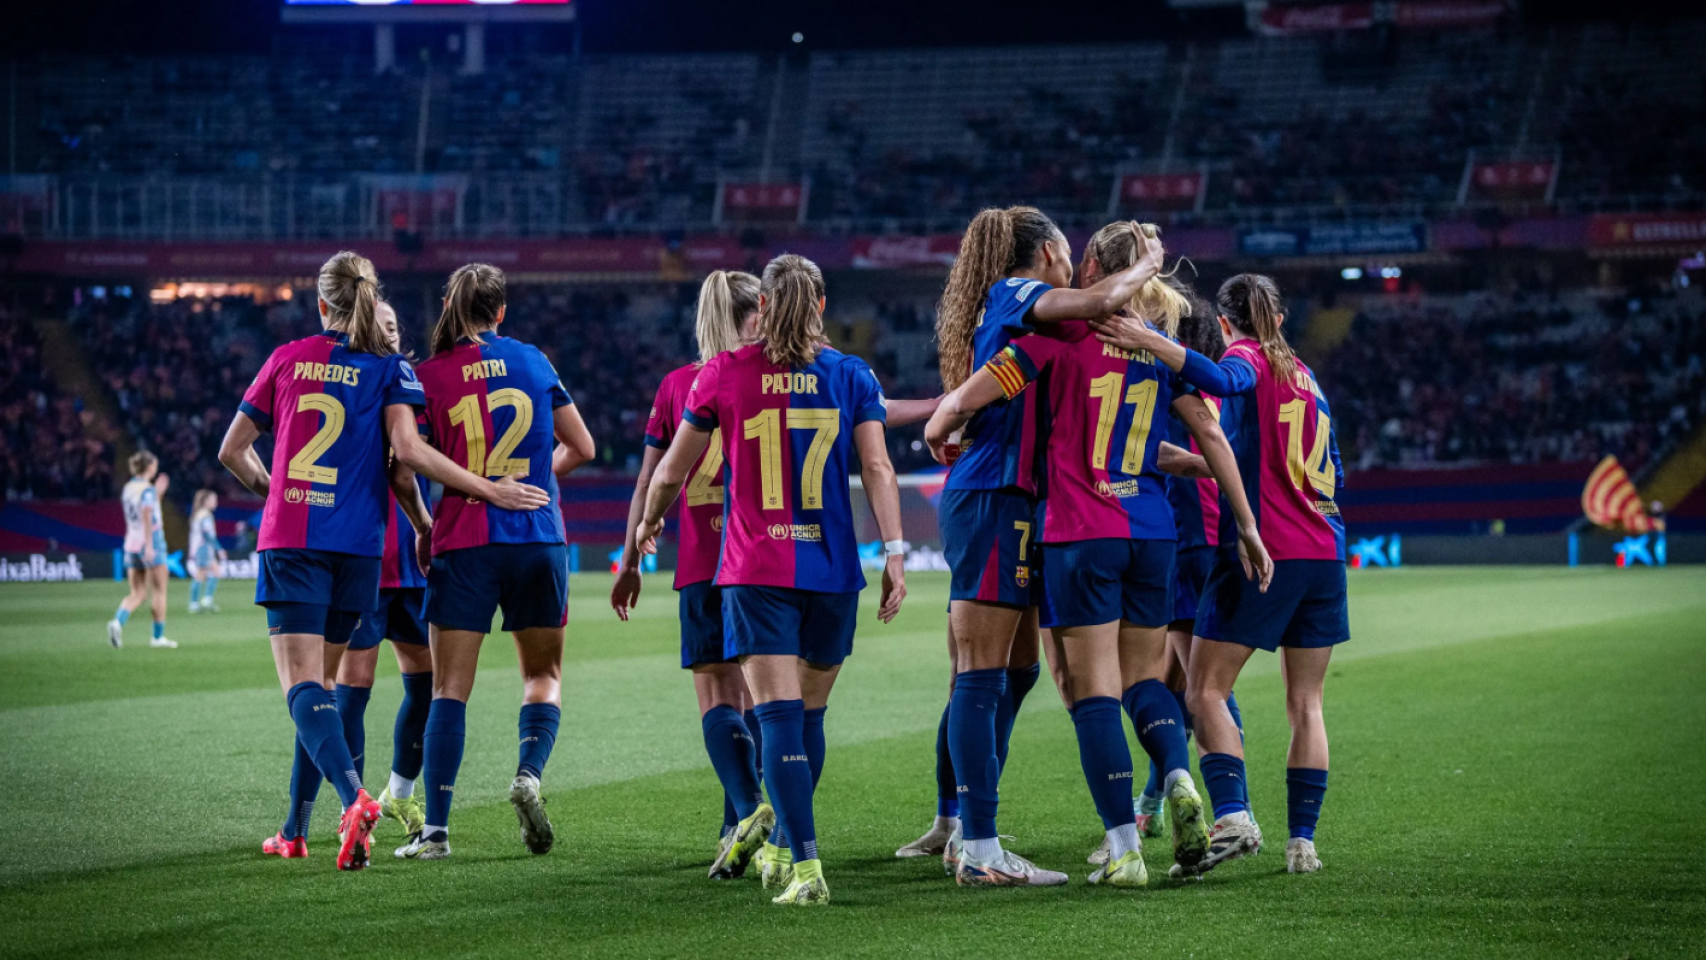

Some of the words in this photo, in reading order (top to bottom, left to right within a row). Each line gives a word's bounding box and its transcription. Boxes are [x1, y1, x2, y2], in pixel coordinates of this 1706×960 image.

[293, 362, 361, 387] PAREDES
[462, 359, 507, 382] PATRI
[762, 372, 819, 395] PAJOR
[288, 393, 345, 484] 2
[448, 388, 533, 478] 12
[1089, 371, 1159, 476] 11
[743, 408, 840, 510] 17
[1278, 398, 1336, 499] 14
[305, 489, 336, 499] UNHCR
[790, 524, 821, 532] UNHCR
[790, 530, 822, 539] ACNUR
[1013, 520, 1030, 561] 7
